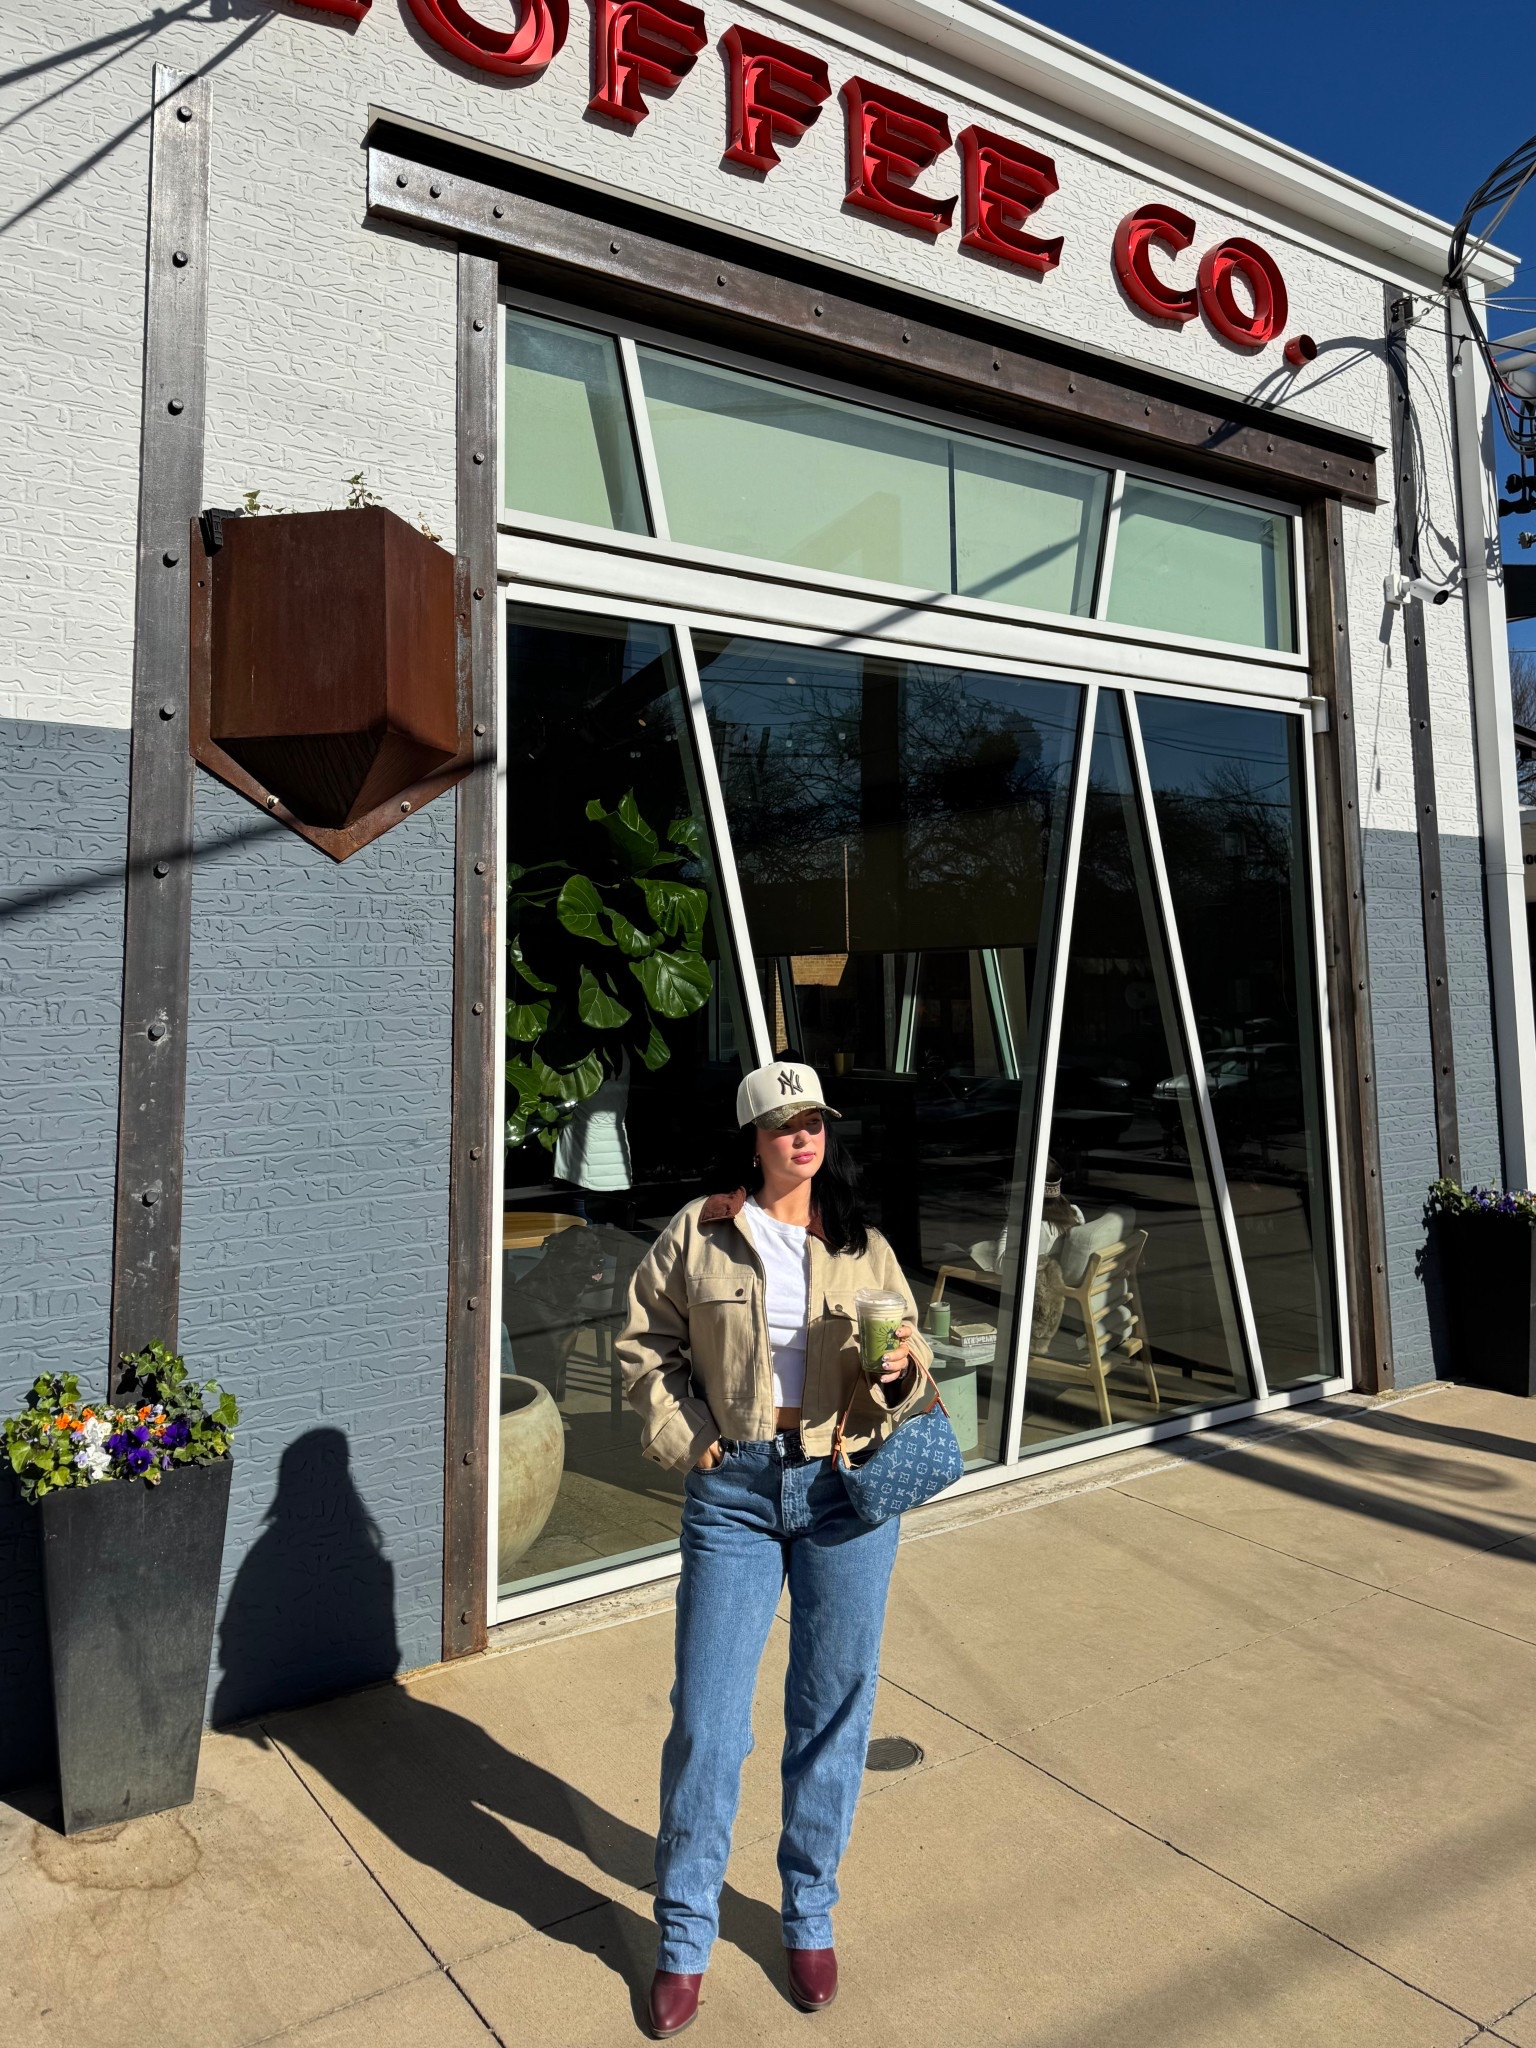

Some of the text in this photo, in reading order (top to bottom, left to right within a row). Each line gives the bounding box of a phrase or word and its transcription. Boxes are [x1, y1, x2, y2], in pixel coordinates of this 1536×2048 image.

[288, 0, 1317, 365] OFFEE CO.
[777, 1069, 803, 1096] NY
